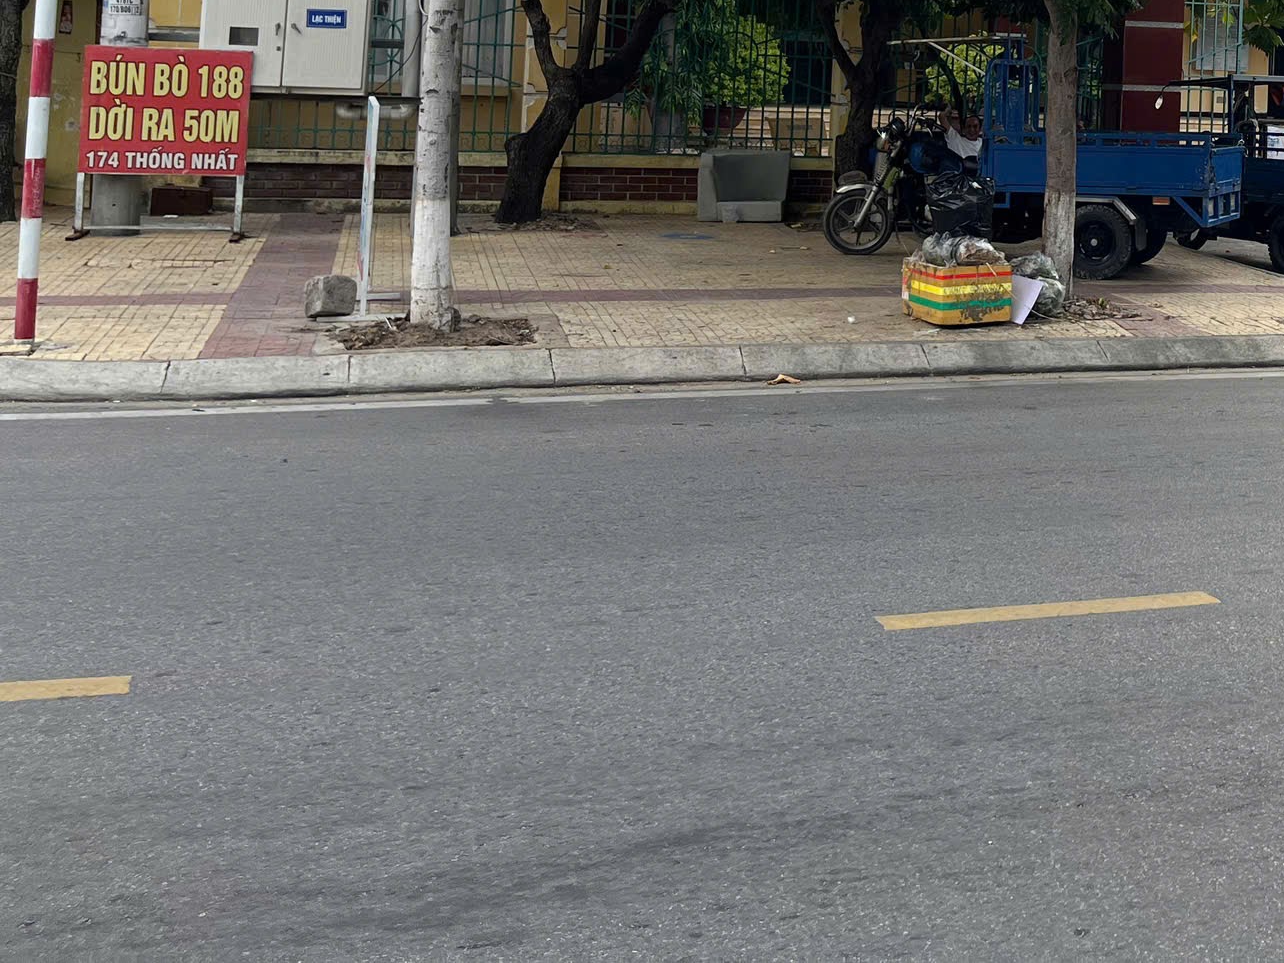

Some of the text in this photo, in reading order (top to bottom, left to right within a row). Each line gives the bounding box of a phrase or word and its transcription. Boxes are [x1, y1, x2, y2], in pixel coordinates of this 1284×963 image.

[311, 14, 342, 25] LẠC THIỆN
[89, 54, 244, 99] BÚN BÒ 188
[88, 98, 240, 143] DỜI RA 50M
[86, 146, 238, 170] 174 THỐNG NHẤT
